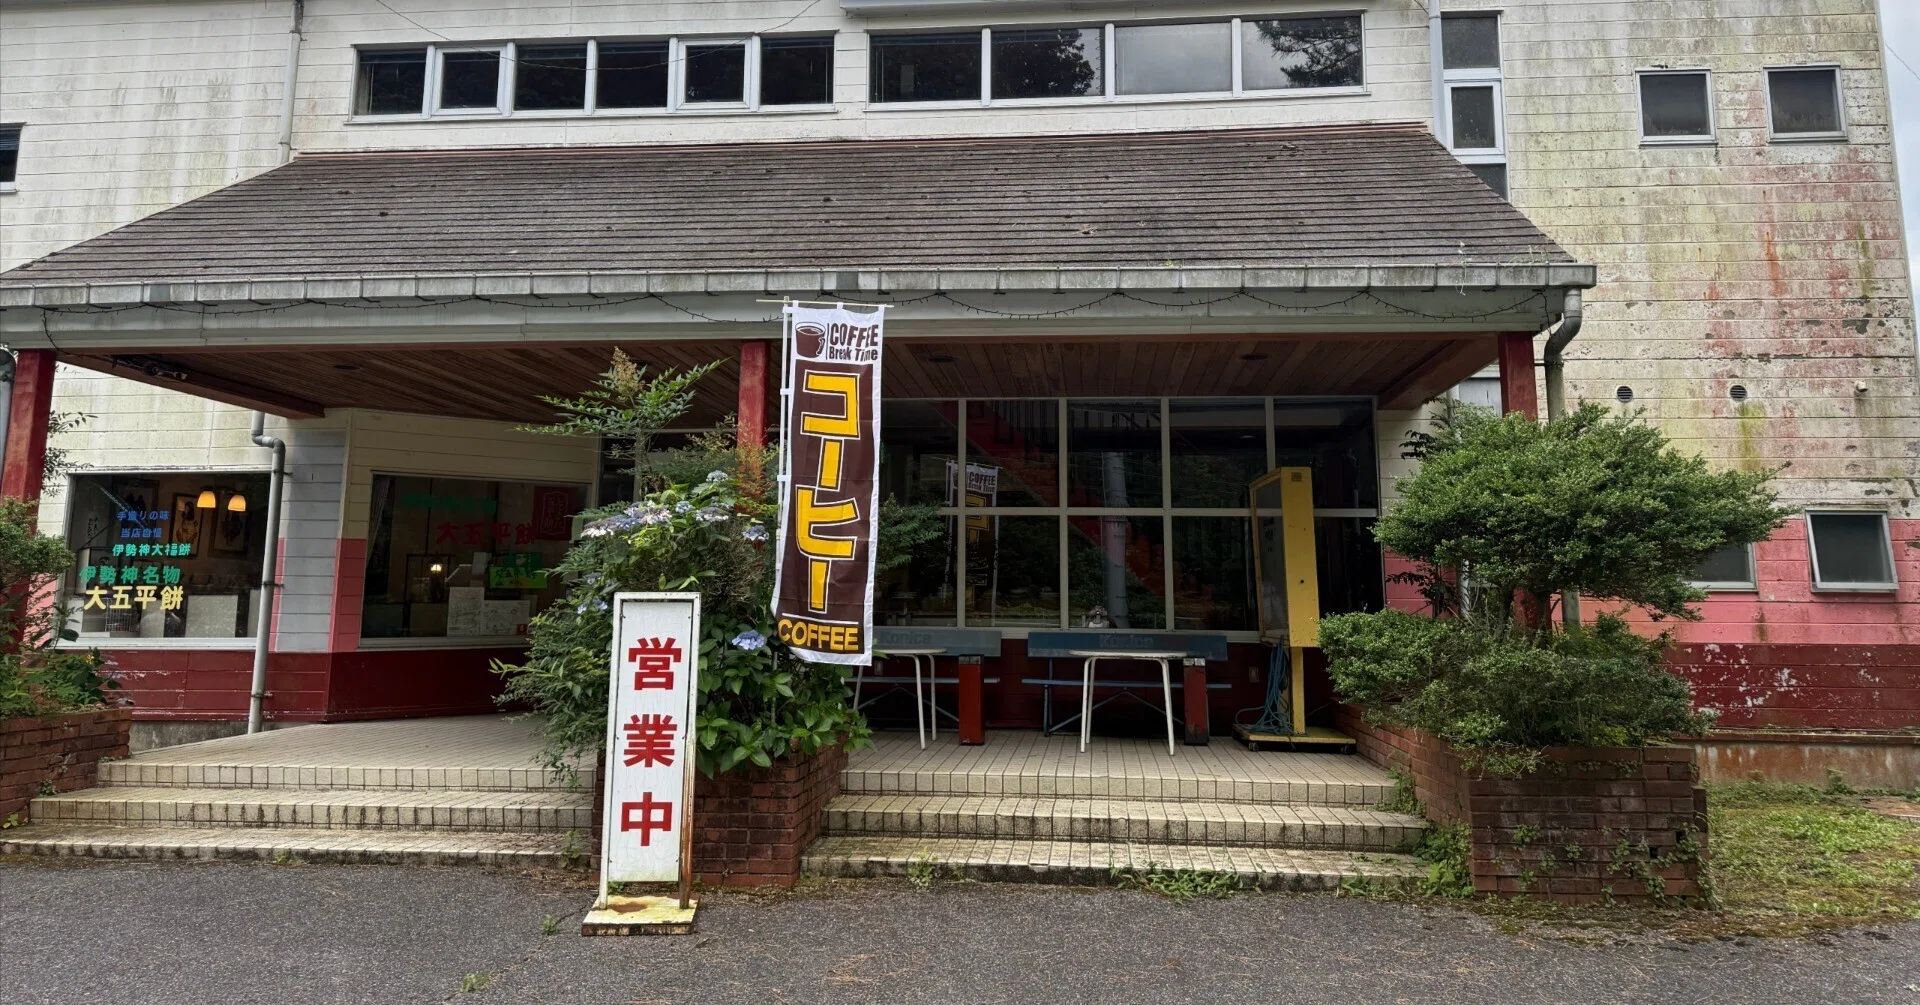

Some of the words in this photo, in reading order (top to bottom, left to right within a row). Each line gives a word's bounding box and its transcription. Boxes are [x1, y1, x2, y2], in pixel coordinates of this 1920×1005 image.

[830, 323, 878, 348] COFFEE
[829, 346, 852, 360] Break
[855, 348, 878, 362] Time
[969, 472, 996, 485] COFFEE
[795, 369, 860, 614] コーヒー
[117, 511, 170, 521] 手造りの味
[121, 528, 162, 538] 当店自慢
[436, 522, 536, 545] 大五平餅
[112, 543, 191, 557] 伊勢神大福餅
[79, 566, 181, 584] 伊勢神名物
[83, 585, 184, 610] 大五平餅
[777, 619, 859, 651] COFFEE
[880, 631, 932, 645] Konica
[620, 637, 682, 846] 営業中
